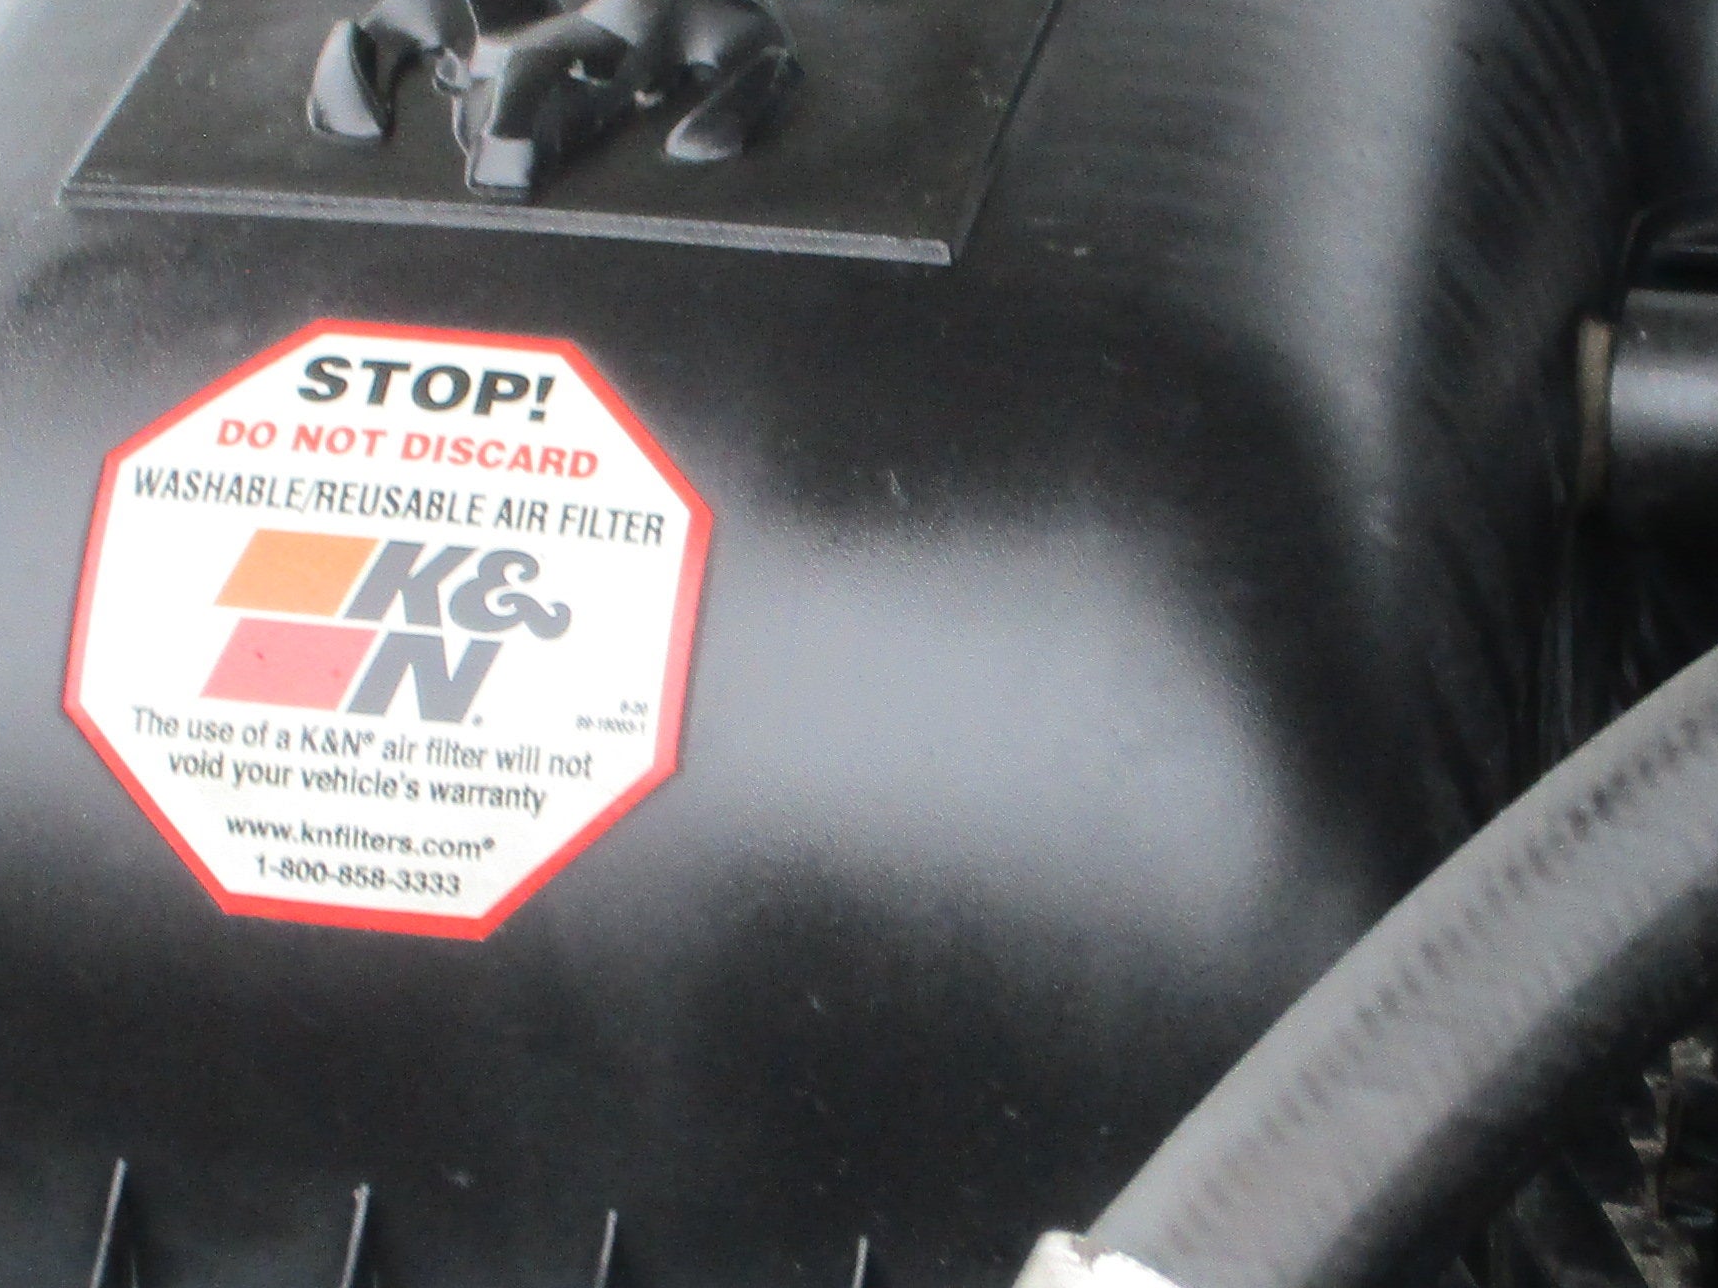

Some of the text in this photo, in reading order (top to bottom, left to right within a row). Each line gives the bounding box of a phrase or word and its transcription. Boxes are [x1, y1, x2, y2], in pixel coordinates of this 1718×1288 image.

[296, 355, 556, 423] STOP!
[216, 418, 599, 480] DO NOT DISCARD
[133, 465, 666, 548] WASHABLE/REUSABLE AIR FILTER
[130, 704, 179, 738] The
[187, 718, 235, 743] use
[242, 718, 273, 748] of
[276, 729, 292, 751] a
[382, 734, 420, 765] air
[425, 736, 489, 773] filter
[494, 745, 542, 777] will
[548, 751, 595, 781] not
[168, 750, 549, 820] void your vehicle's warranty
[254, 853, 463, 897] 1-800-858-3333
